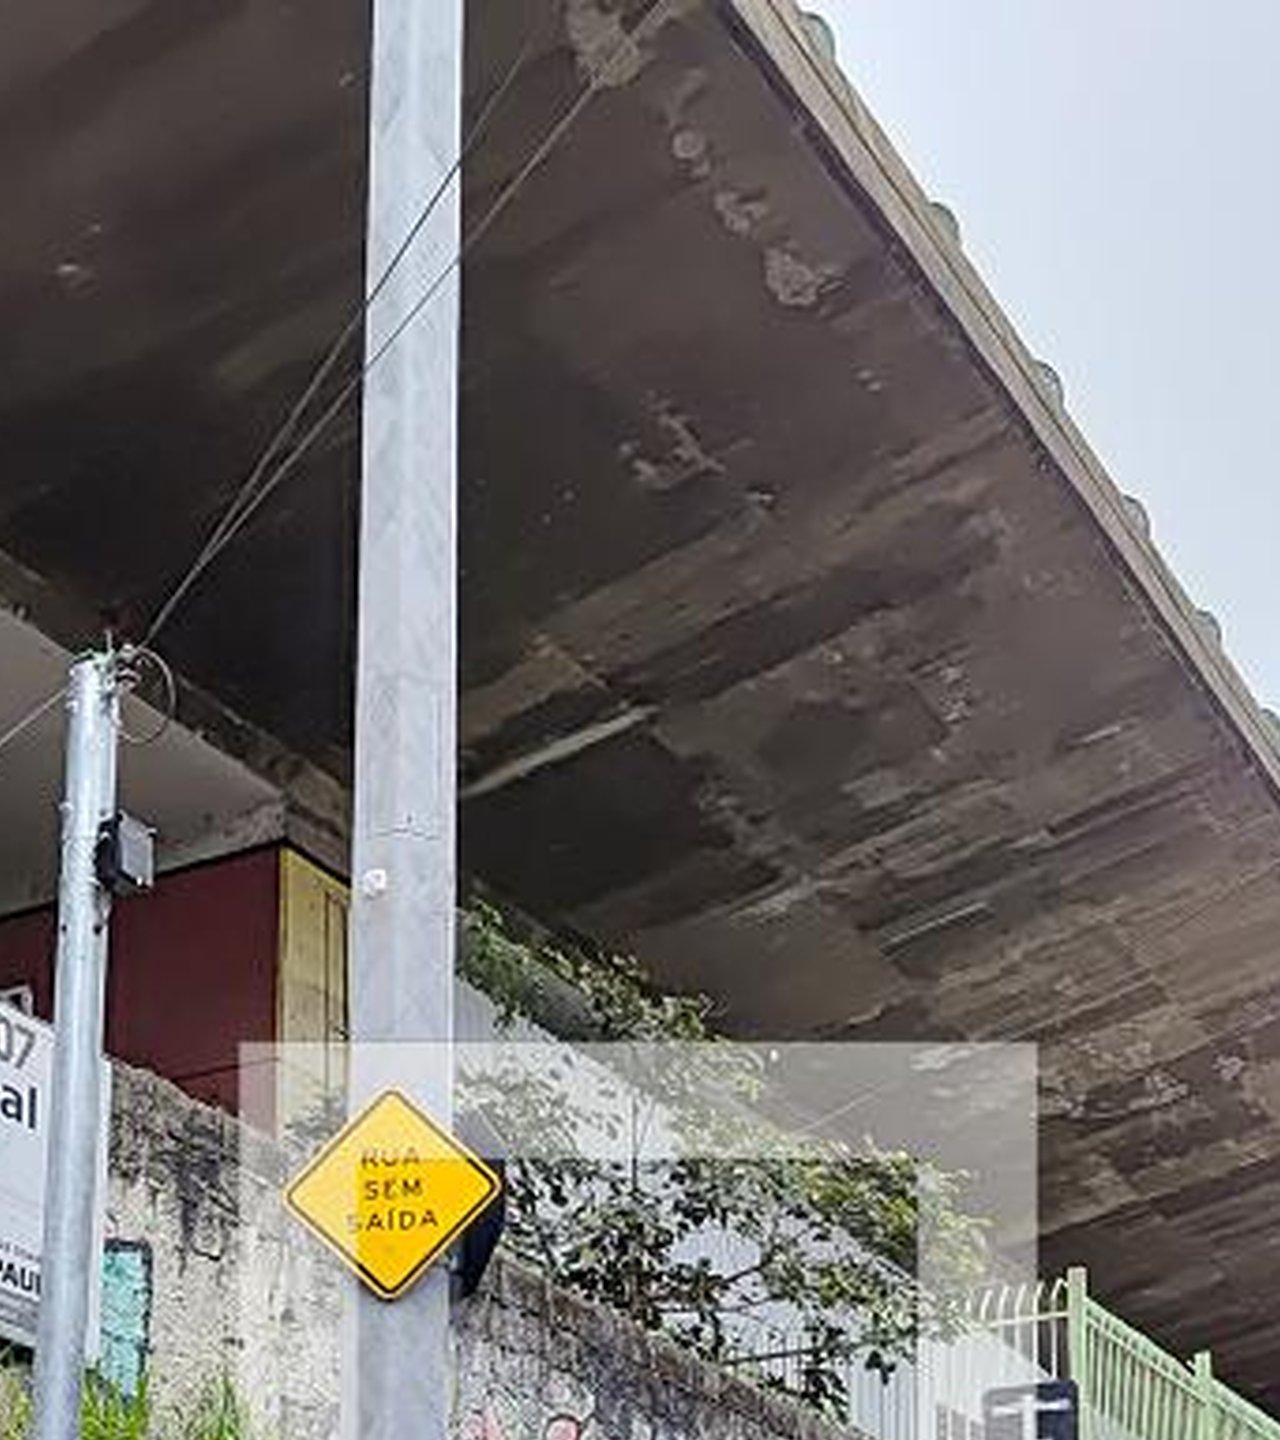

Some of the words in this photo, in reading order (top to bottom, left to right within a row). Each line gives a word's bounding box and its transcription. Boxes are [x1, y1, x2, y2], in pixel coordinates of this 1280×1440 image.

[361, 1147, 421, 1170] RUA
[364, 1178, 424, 1201] SEM
[347, 1209, 439, 1234] SAÍDA
